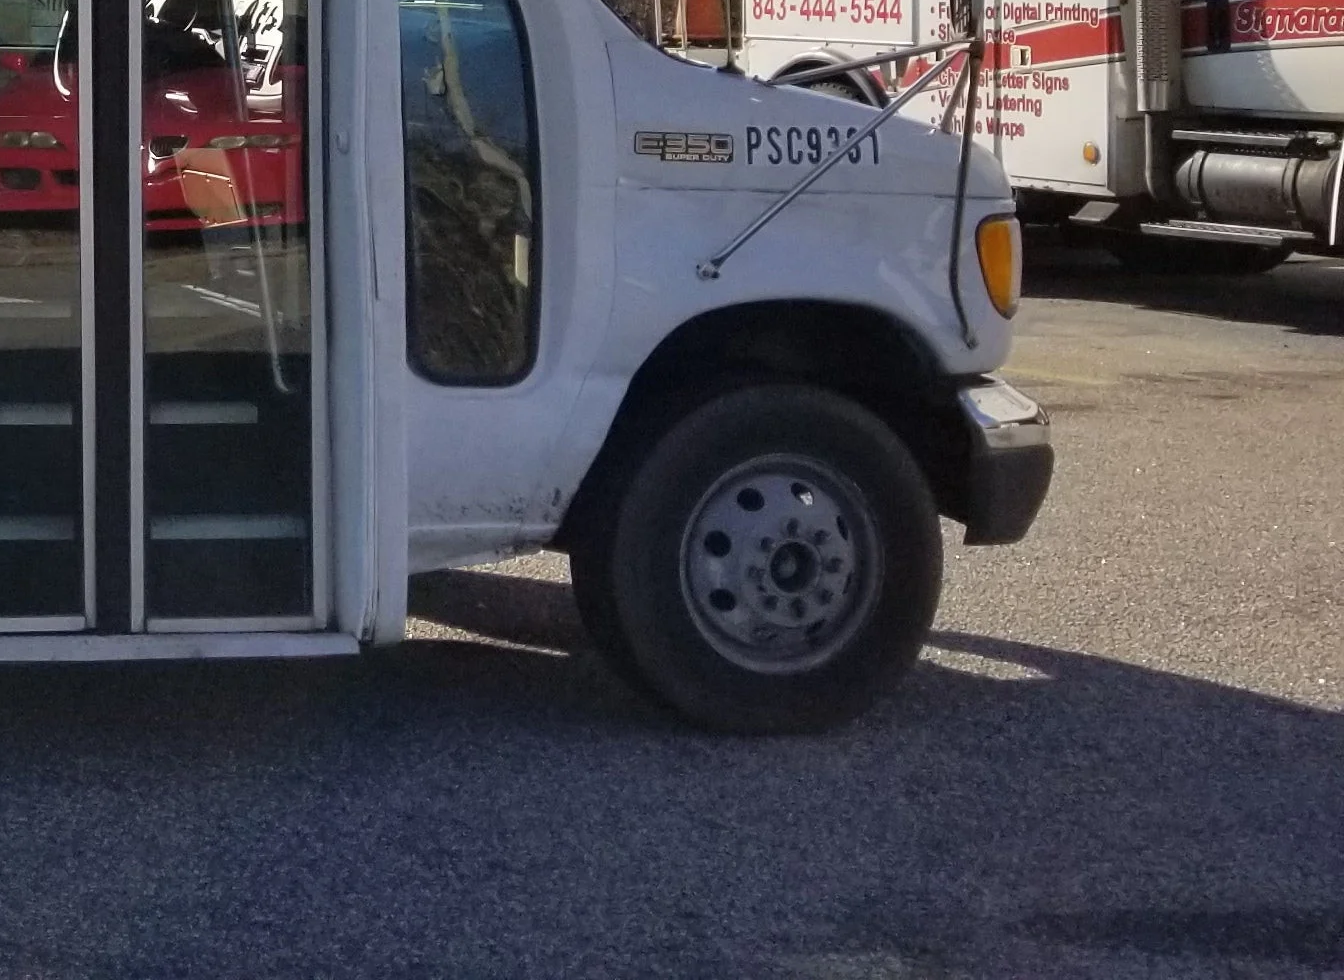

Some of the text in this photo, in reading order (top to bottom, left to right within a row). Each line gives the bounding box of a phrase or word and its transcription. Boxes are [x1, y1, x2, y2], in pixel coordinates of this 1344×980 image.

[1003, 2, 1041, 24] Digital
[1045, 2, 1100, 26] Printing
[1032, 71, 1070, 95] Signs
[986, 92, 1043, 117] Lettering
[986, 117, 1025, 140] Wraps
[702, 154, 730, 162] DUTY
